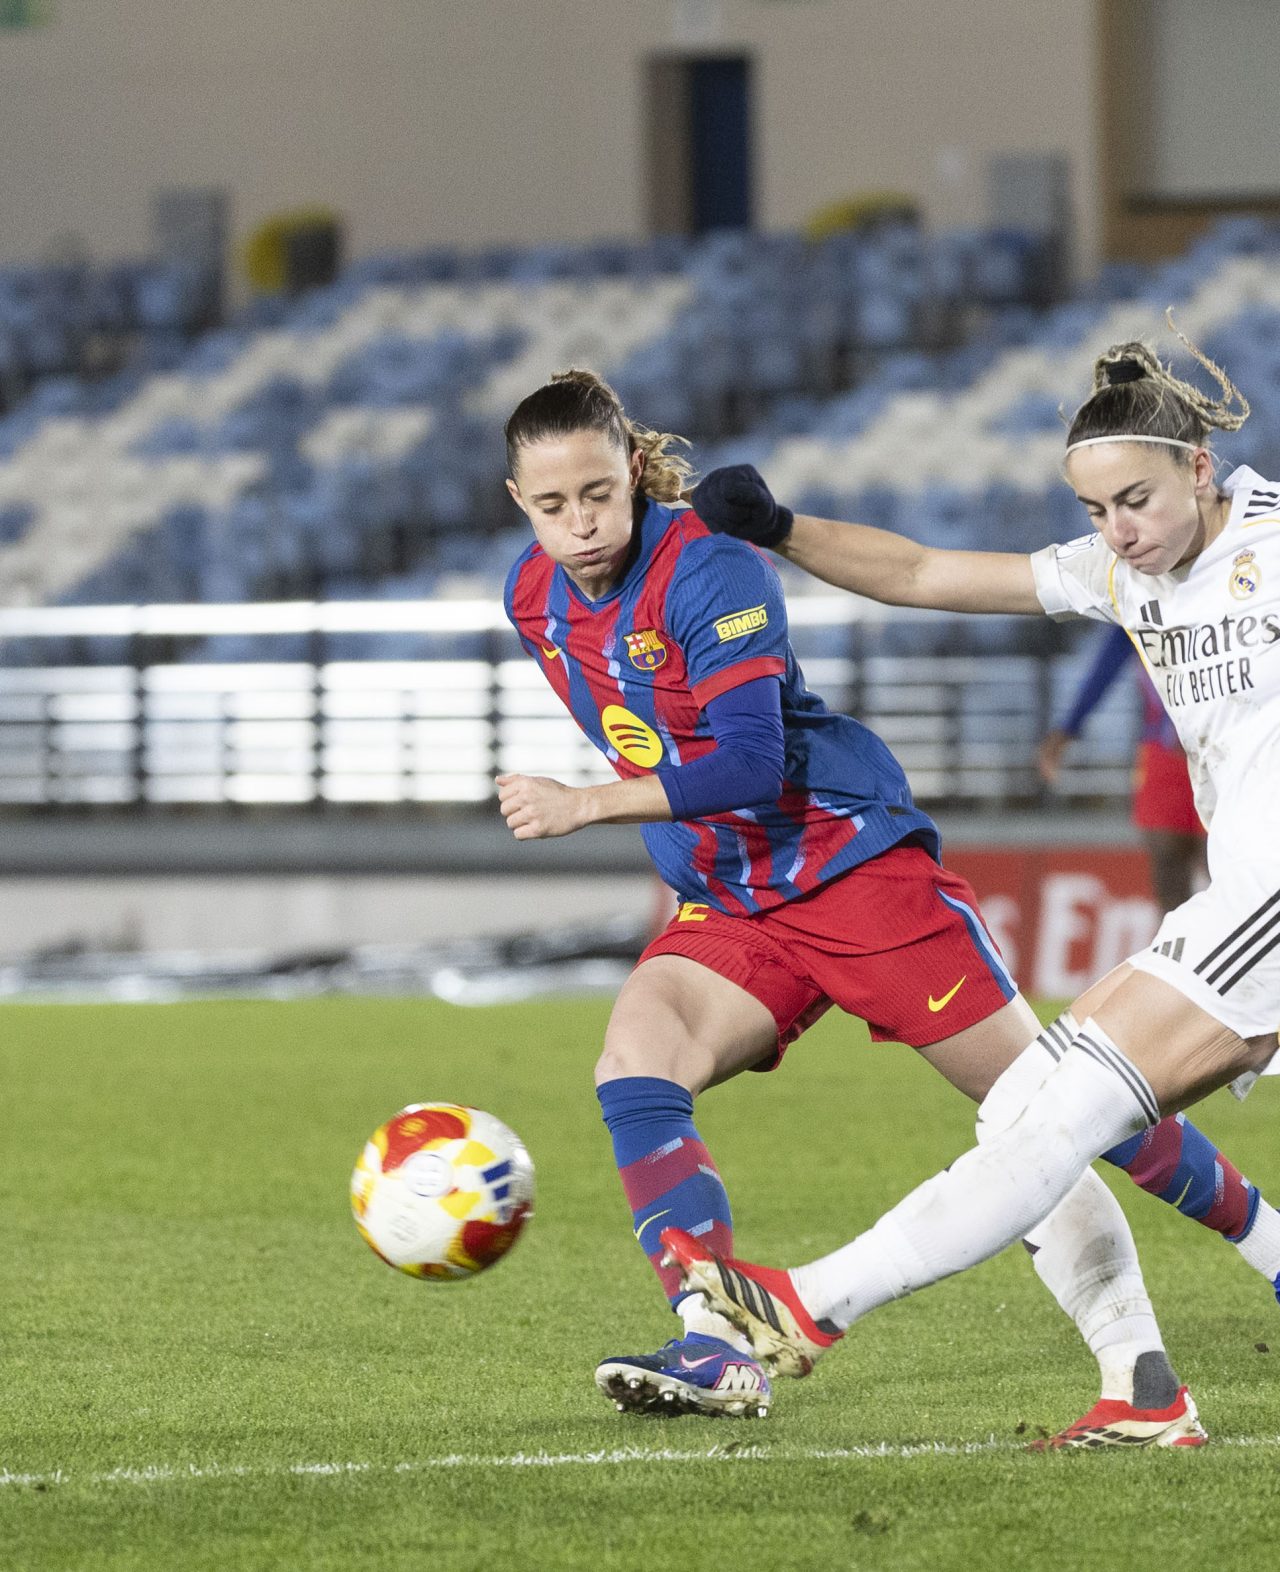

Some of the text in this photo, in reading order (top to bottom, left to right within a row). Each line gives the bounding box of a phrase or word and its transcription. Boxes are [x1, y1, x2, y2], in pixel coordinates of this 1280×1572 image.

[716, 609, 767, 639] BIMBO
[1166, 656, 1254, 708] FLY BETTER
